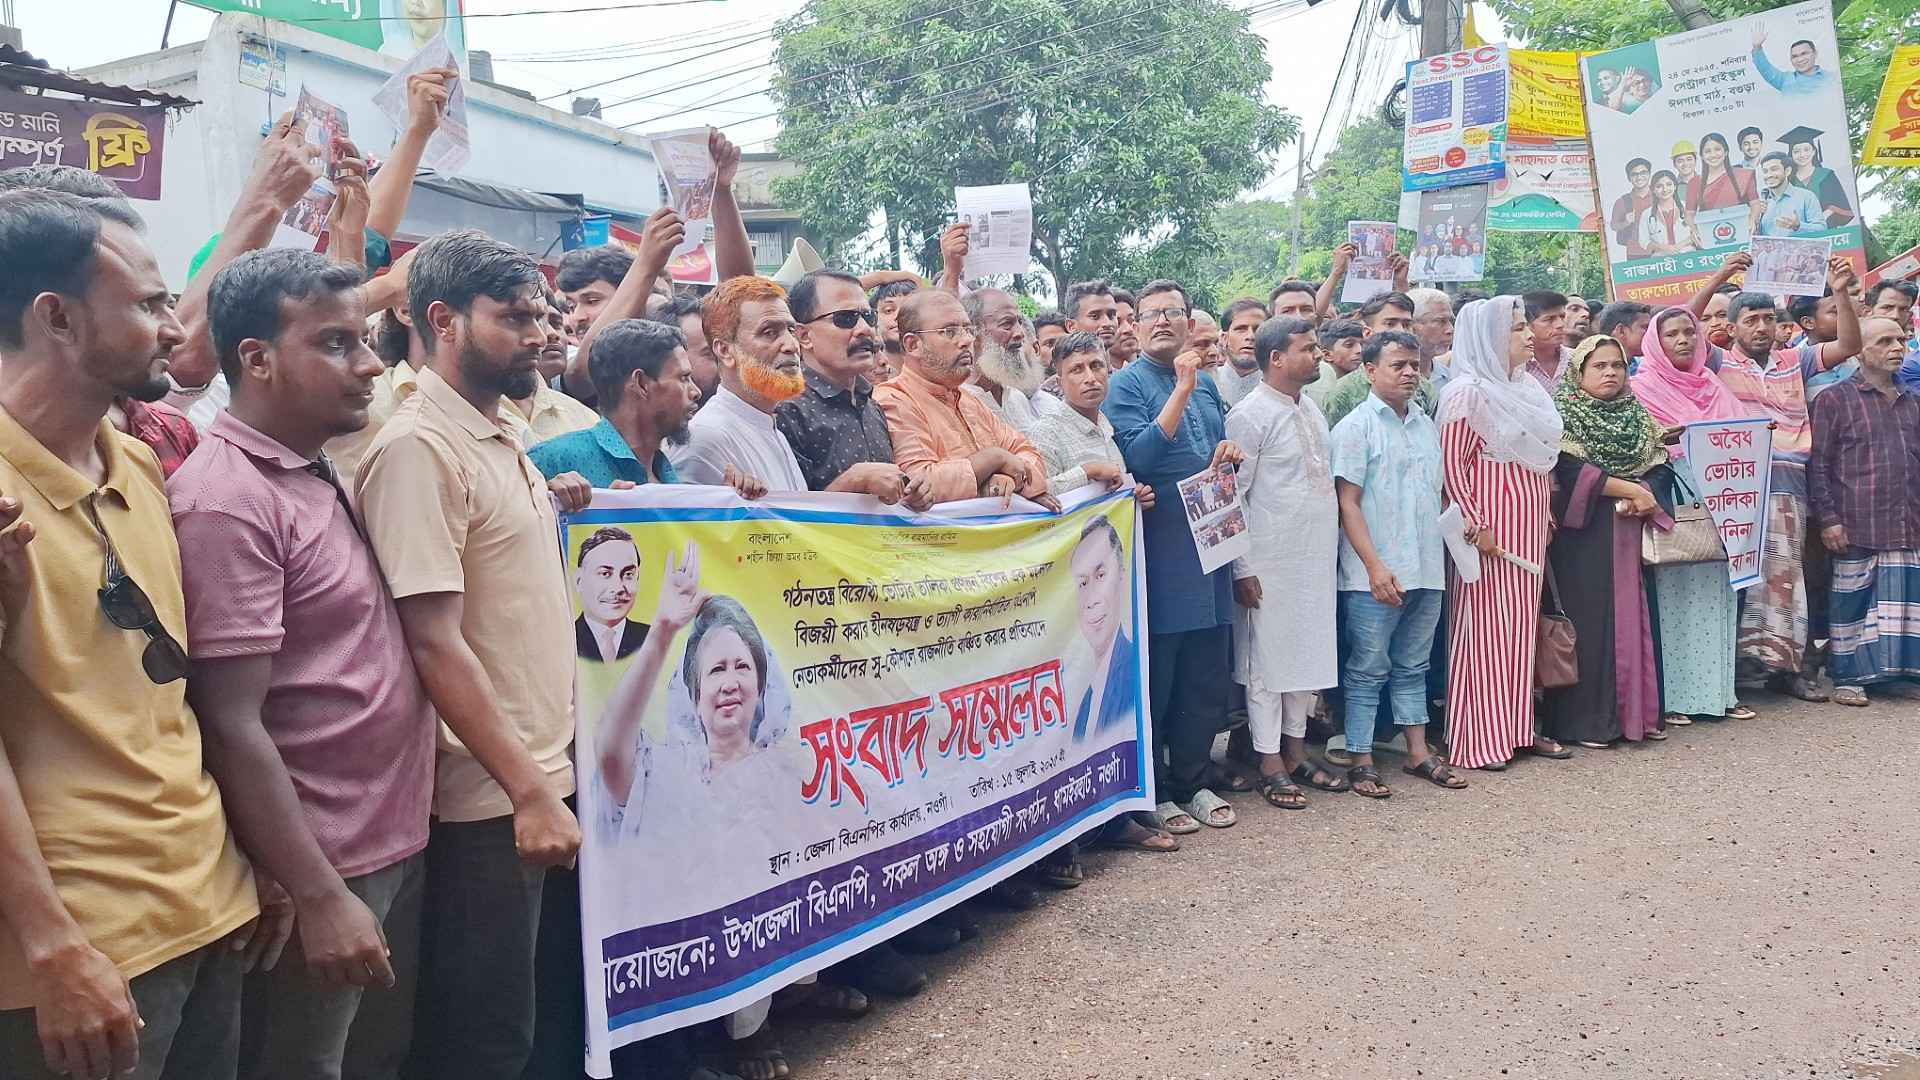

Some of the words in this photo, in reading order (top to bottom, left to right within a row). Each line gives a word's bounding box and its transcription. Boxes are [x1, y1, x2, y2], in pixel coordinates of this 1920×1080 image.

[1429, 46, 1500, 73] SSC
[19, 112, 61, 134] মানি
[81, 112, 151, 173] ফ্রি
[1624, 257, 1679, 278] রাজশাহী
[1684, 260, 1694, 269] ও
[1626, 283, 1681, 301] তারুণ্যের
[1707, 429, 1753, 449] অবৈধ
[1705, 458, 1756, 482] ভোটার
[1704, 487, 1759, 513] তালিকা
[746, 532, 791, 545] বাংলাদেশ
[1719, 518, 1754, 543] ানিনা
[783, 580, 836, 608] গঠনতন্ত্র
[838, 577, 878, 604] বিরোধী
[794, 617, 838, 647] বিজয়ী
[841, 620, 868, 642] করার
[924, 614, 934, 629] ও
[936, 603, 963, 629] ত্যাগী
[793, 654, 868, 688] নেতাকর্মীদের
[917, 636, 956, 664] রাজনীতি
[984, 627, 1007, 646] করার
[1008, 619, 1048, 642] প্রতিবাদে
[799, 695, 935, 814] সংবাদ
[938, 657, 1068, 762] সম্মেলন
[1015, 760, 1039, 784] জুলাই
[768, 850, 791, 876] স্থান
[804, 838, 835, 863] জেলা
[838, 820, 886, 853] বিএনপির
[889, 804, 927, 835] কার্যালয়,
[722, 896, 802, 960] উপজেলা
[806, 864, 876, 927] বিএনপি,
[882, 853, 921, 895] সকল
[925, 843, 951, 882] অঙ্গ
[953, 840, 965, 864] ও
[967, 805, 1015, 859] সহযোগী
[1015, 791, 1050, 843] সংগঠন,
